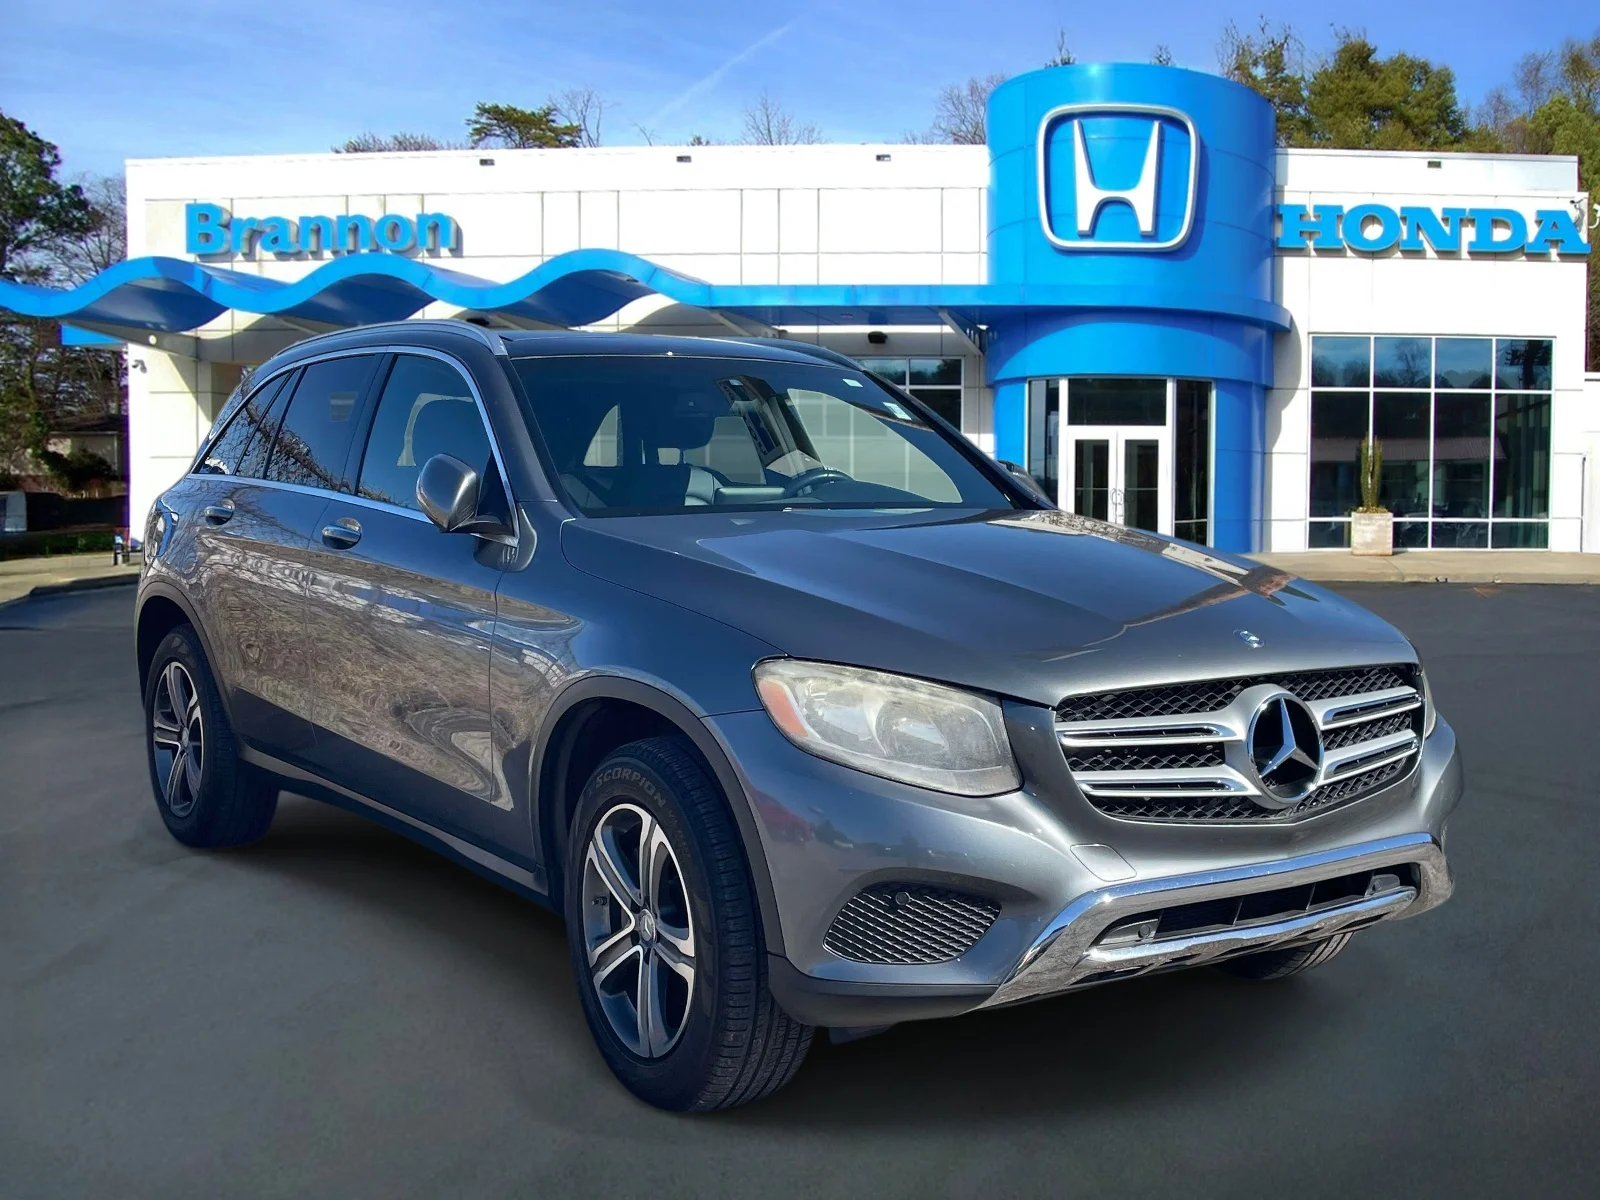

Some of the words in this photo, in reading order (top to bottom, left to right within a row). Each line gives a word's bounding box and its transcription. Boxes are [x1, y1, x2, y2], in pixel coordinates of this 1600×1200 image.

[185, 202, 458, 256] Brannon
[1276, 203, 1591, 254] HONDA
[595, 767, 667, 808] SCORPION
